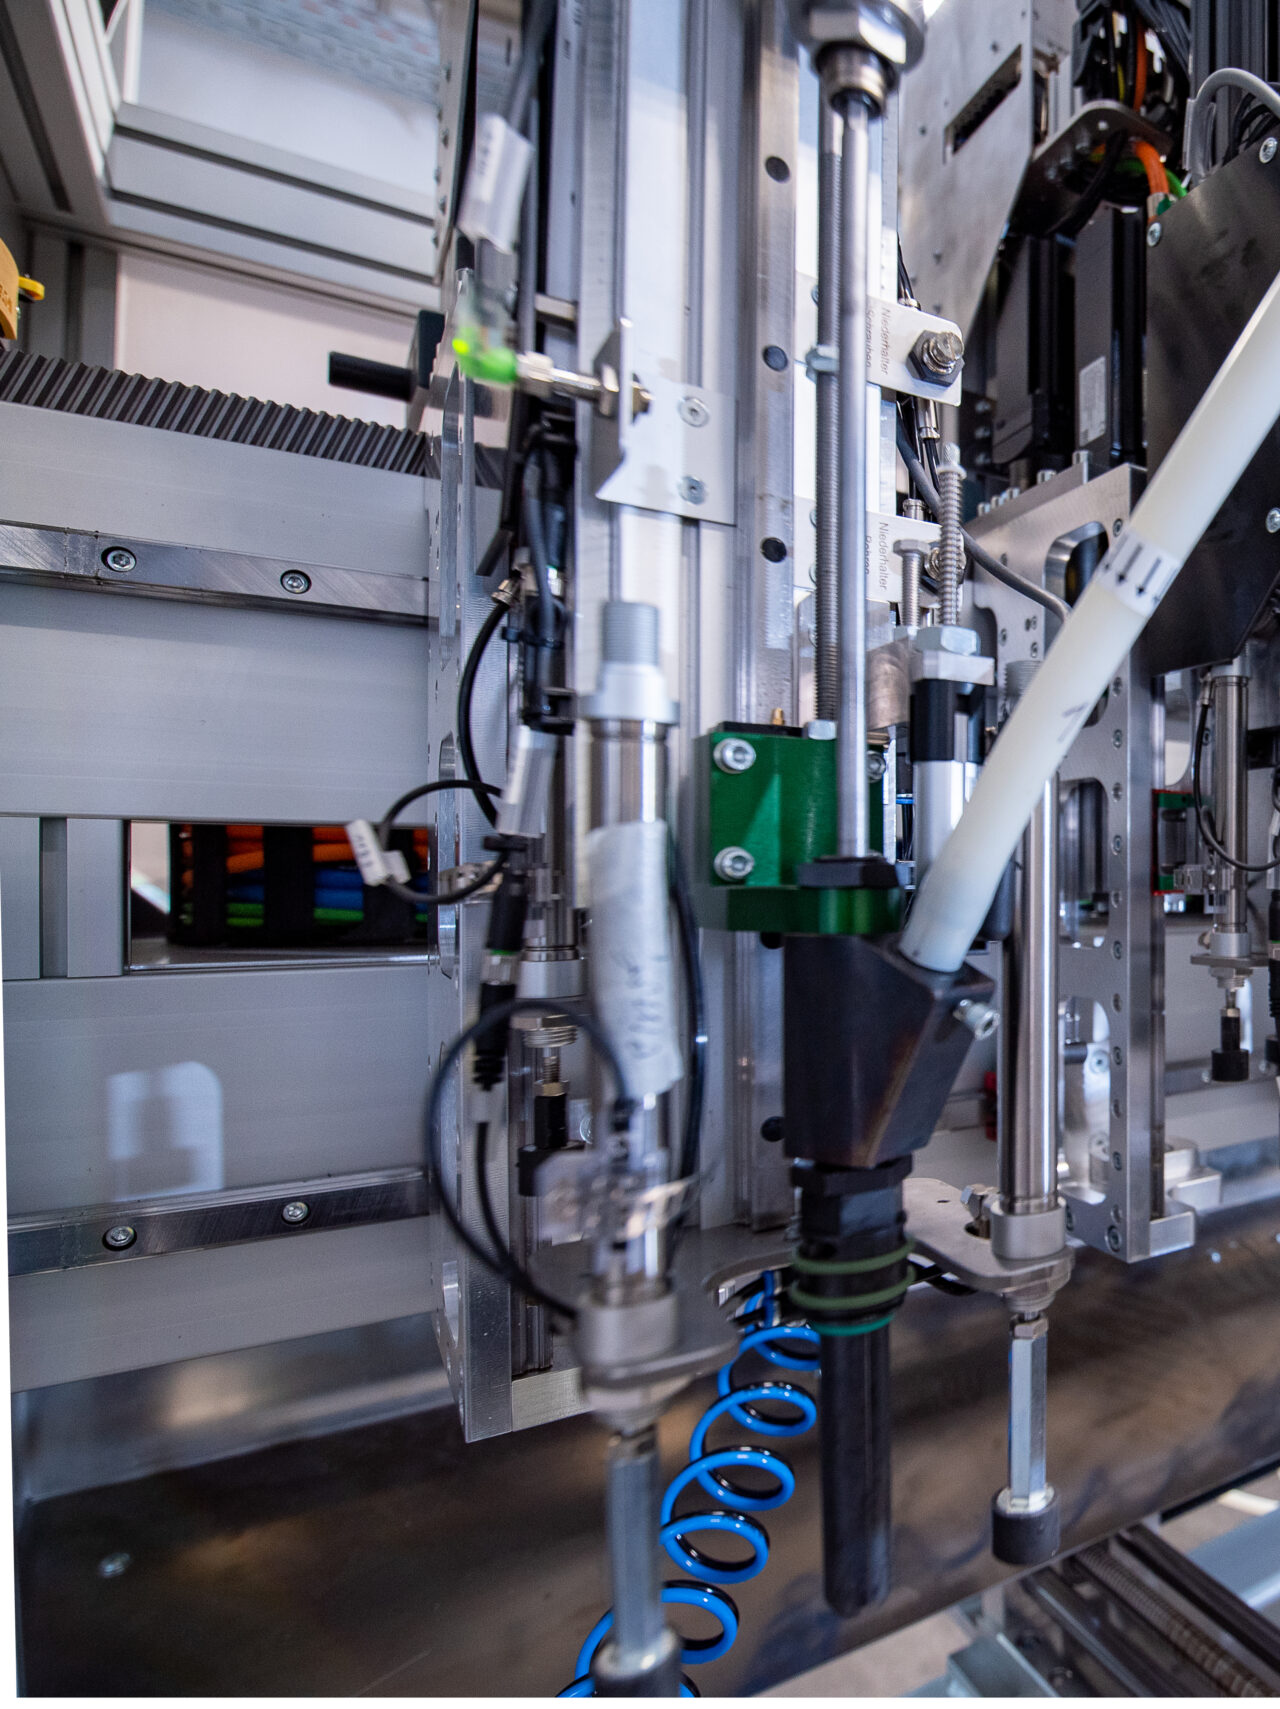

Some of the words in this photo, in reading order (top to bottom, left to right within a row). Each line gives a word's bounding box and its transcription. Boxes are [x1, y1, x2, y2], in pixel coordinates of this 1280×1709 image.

[865, 309, 875, 368] Schrauben
[880, 307, 891, 375] Niederhalter
[879, 522, 889, 591] Niederhalter
